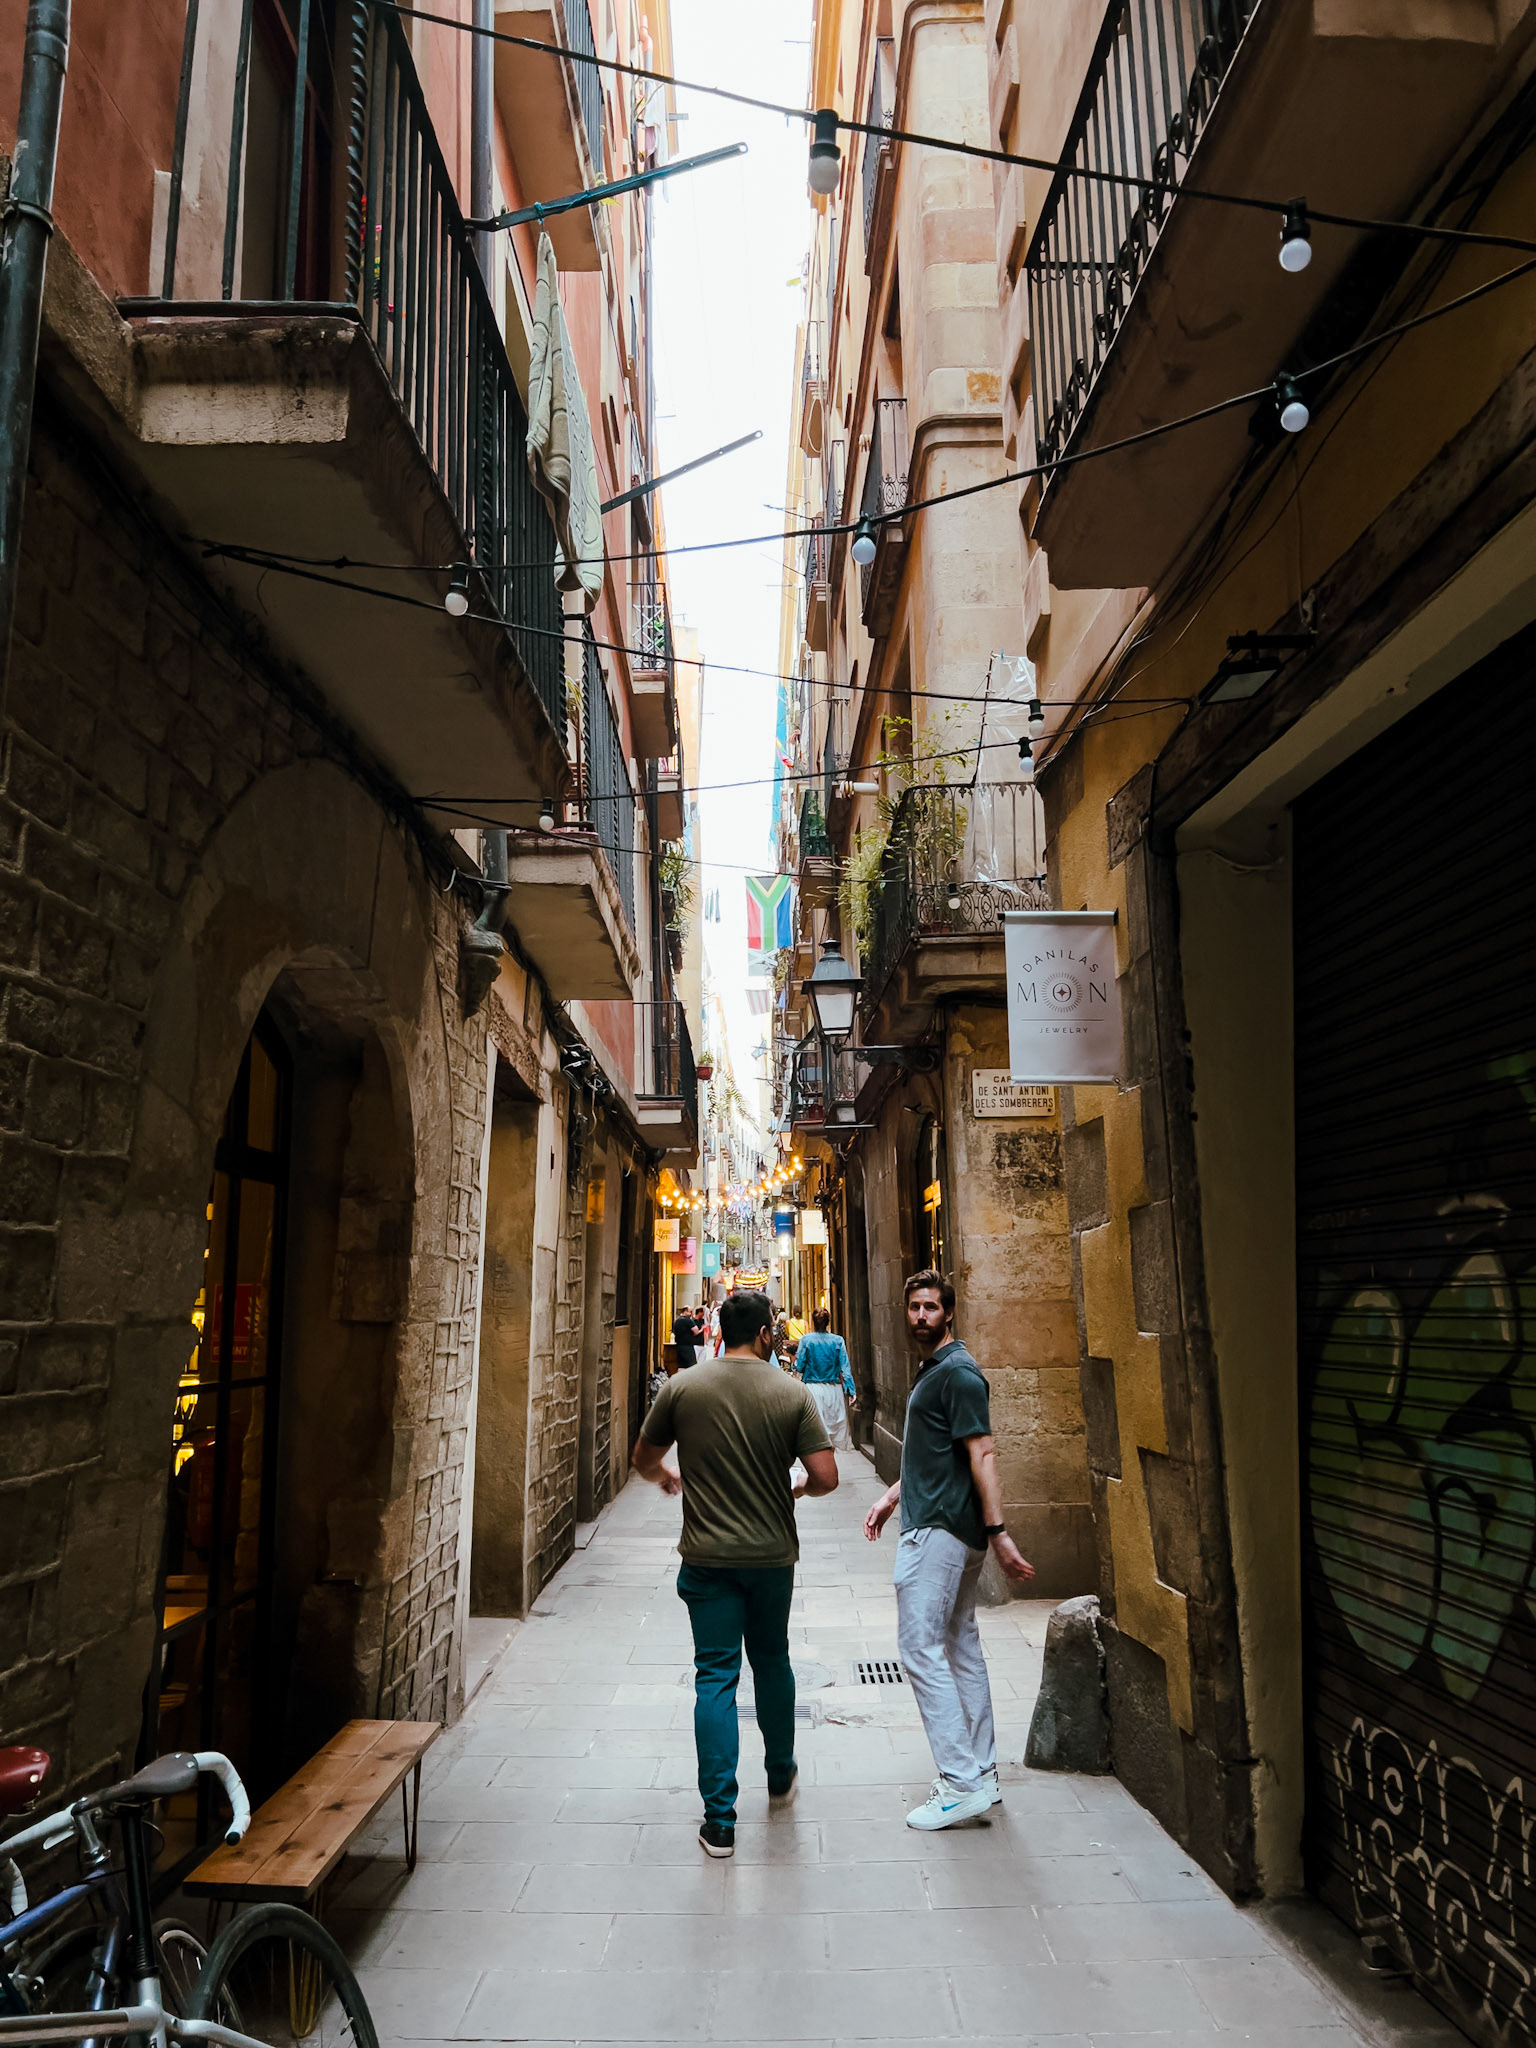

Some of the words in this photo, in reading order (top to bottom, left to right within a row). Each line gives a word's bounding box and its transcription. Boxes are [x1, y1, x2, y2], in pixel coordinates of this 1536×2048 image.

[1022, 949, 1100, 974] DANILAS
[1039, 1026, 1088, 1034] JEWELRY
[978, 1086, 988, 1096] DE
[992, 1086, 1015, 1096] SANT
[1019, 1085, 1049, 1096] ANTONI
[975, 1098, 996, 1109] DELS
[999, 1098, 1054, 1108] SOMBRERERS
